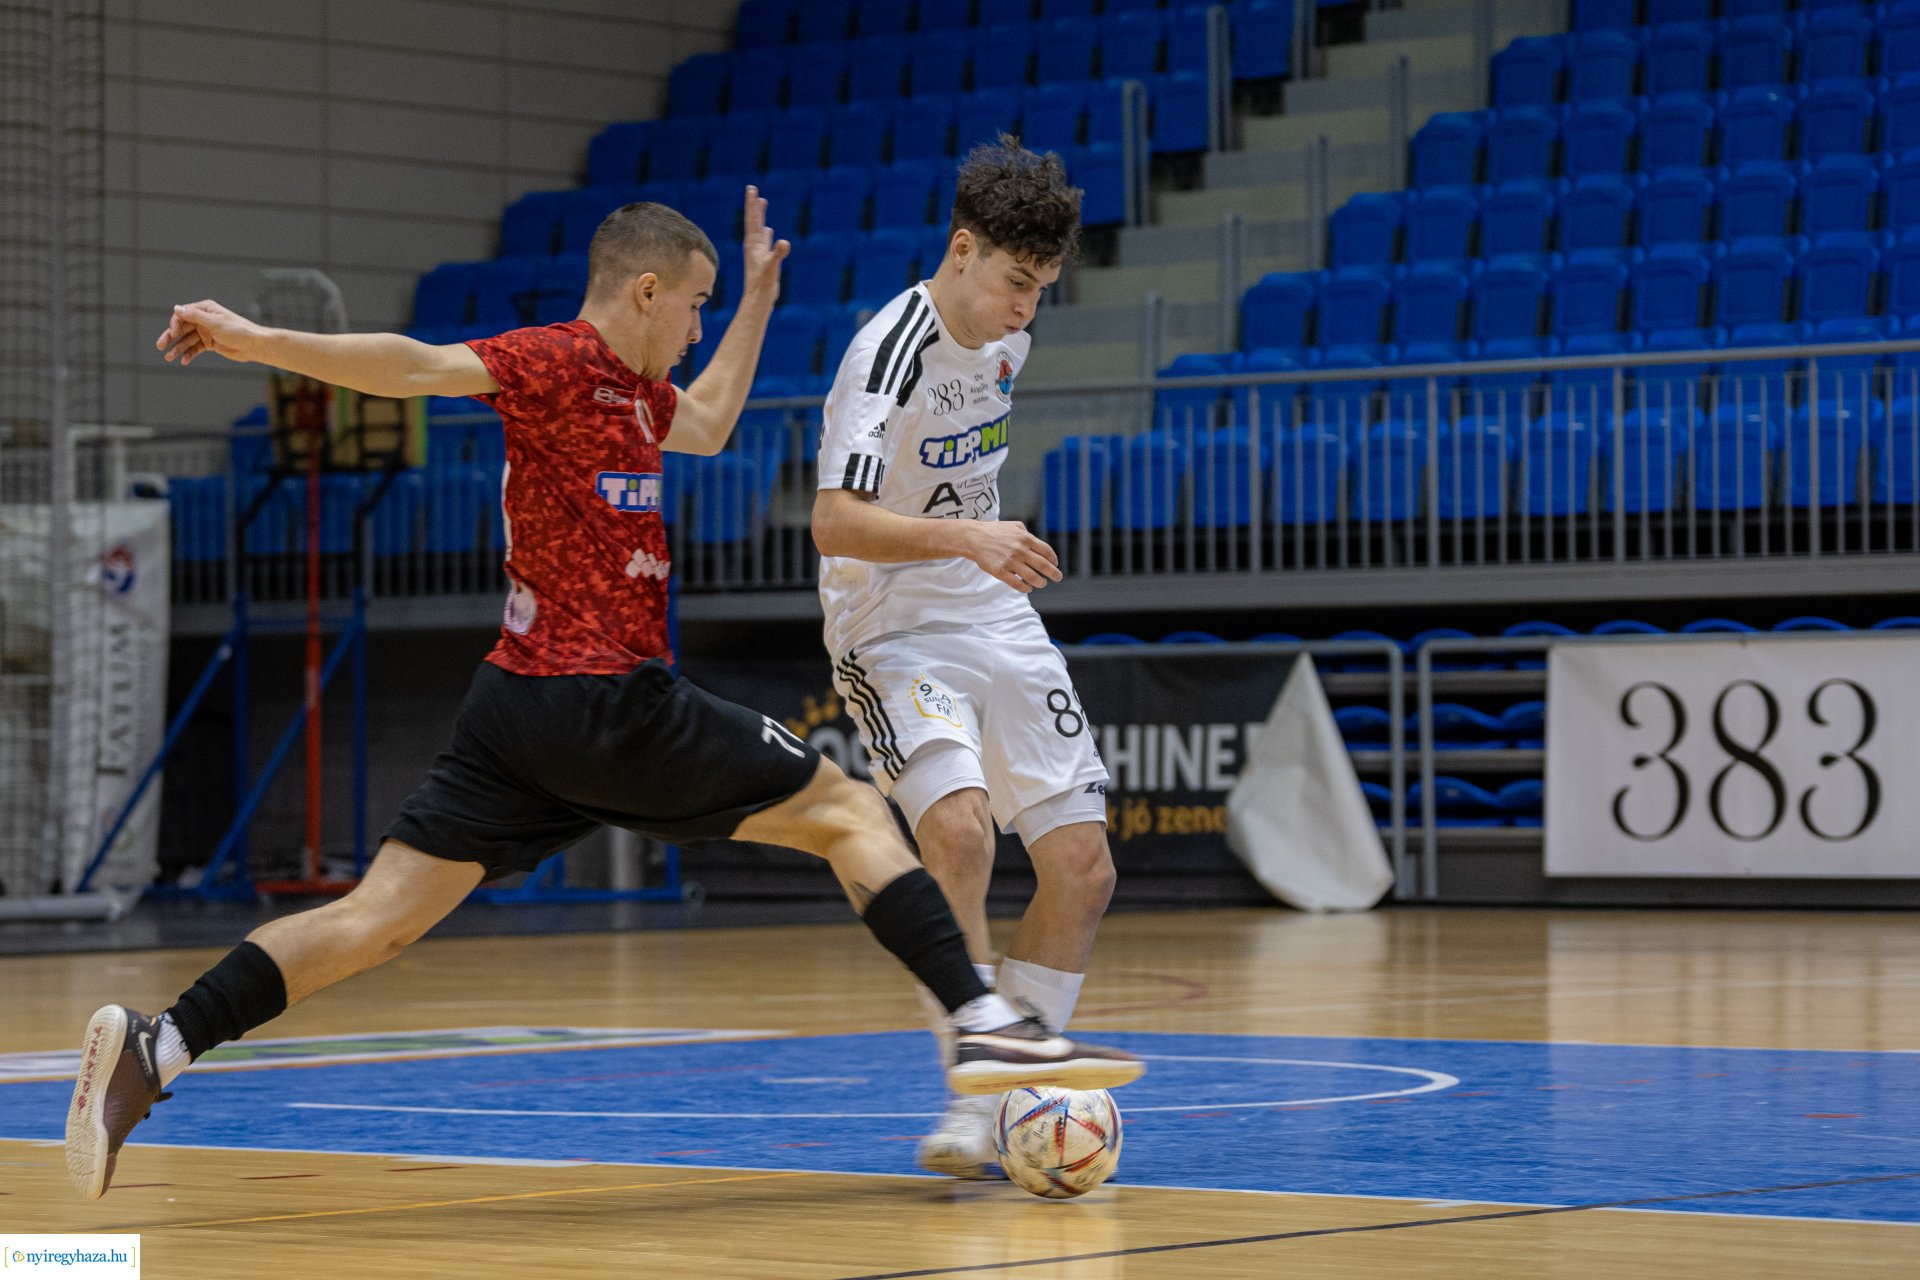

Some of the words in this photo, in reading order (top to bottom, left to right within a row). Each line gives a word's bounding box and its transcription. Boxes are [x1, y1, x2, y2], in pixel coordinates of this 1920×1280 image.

[928, 379, 964, 416] 383
[920, 415, 1009, 467] TiPPMI
[1047, 687, 1090, 738] 8
[1092, 723, 1238, 792] HINE
[1611, 678, 1883, 843] 383
